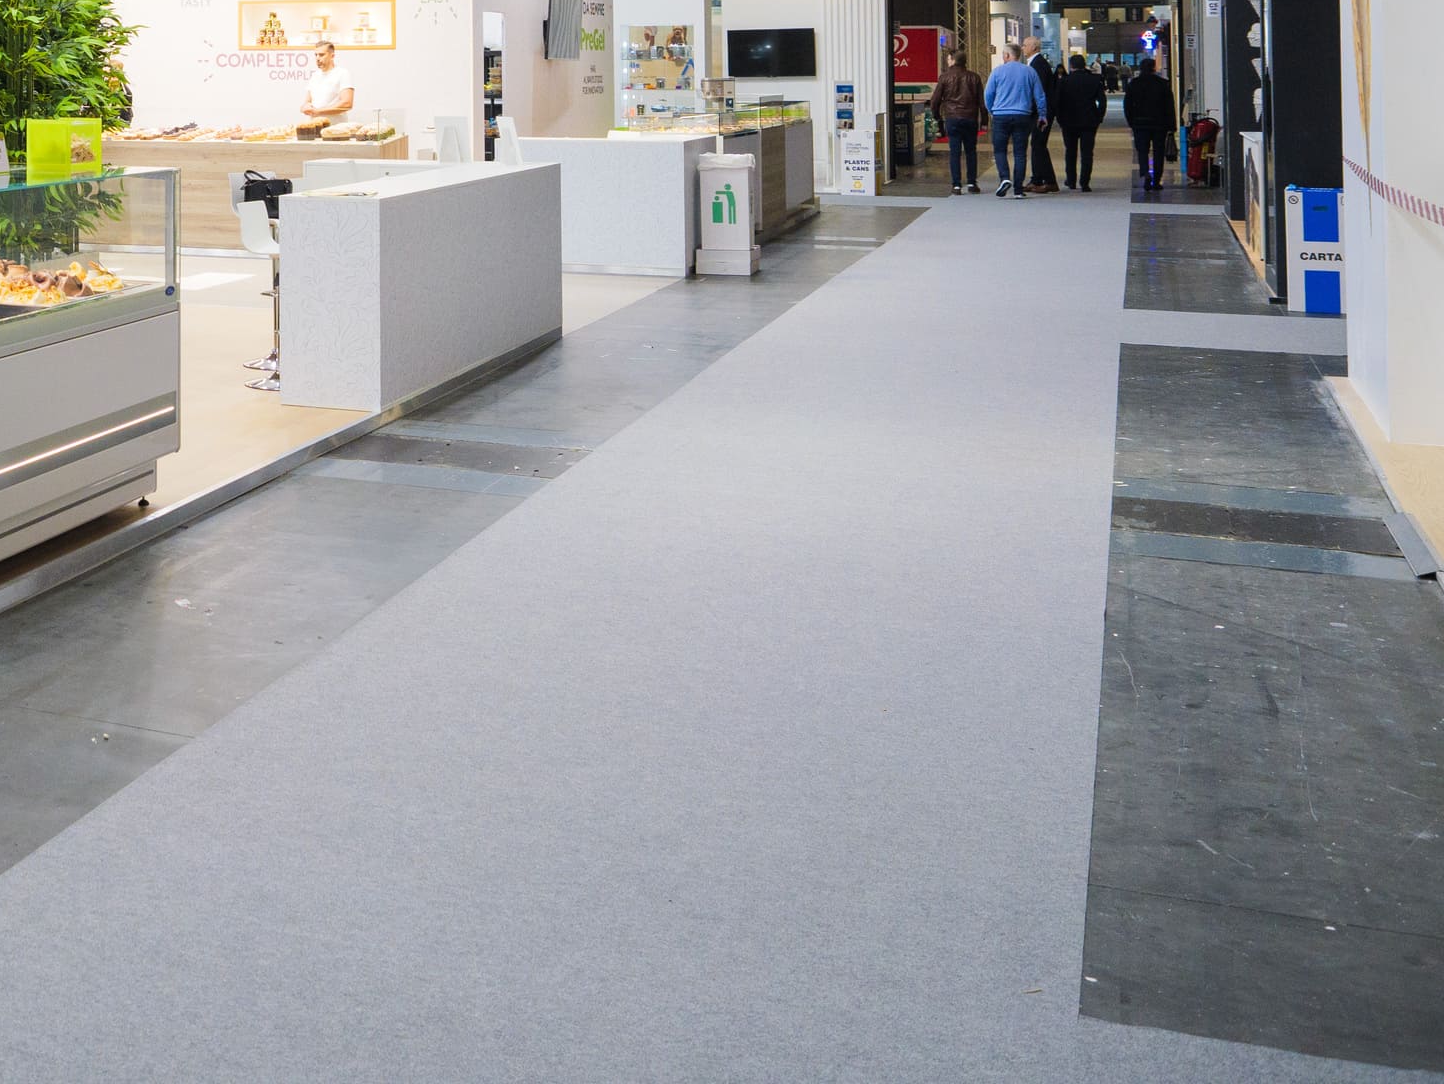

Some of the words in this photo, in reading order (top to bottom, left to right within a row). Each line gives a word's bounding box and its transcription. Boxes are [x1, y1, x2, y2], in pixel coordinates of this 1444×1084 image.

[580, 27, 605, 53] PreGel
[216, 53, 309, 68] COMPLETO
[269, 70, 316, 81] COMPL
[1299, 252, 1344, 262] CARTA
